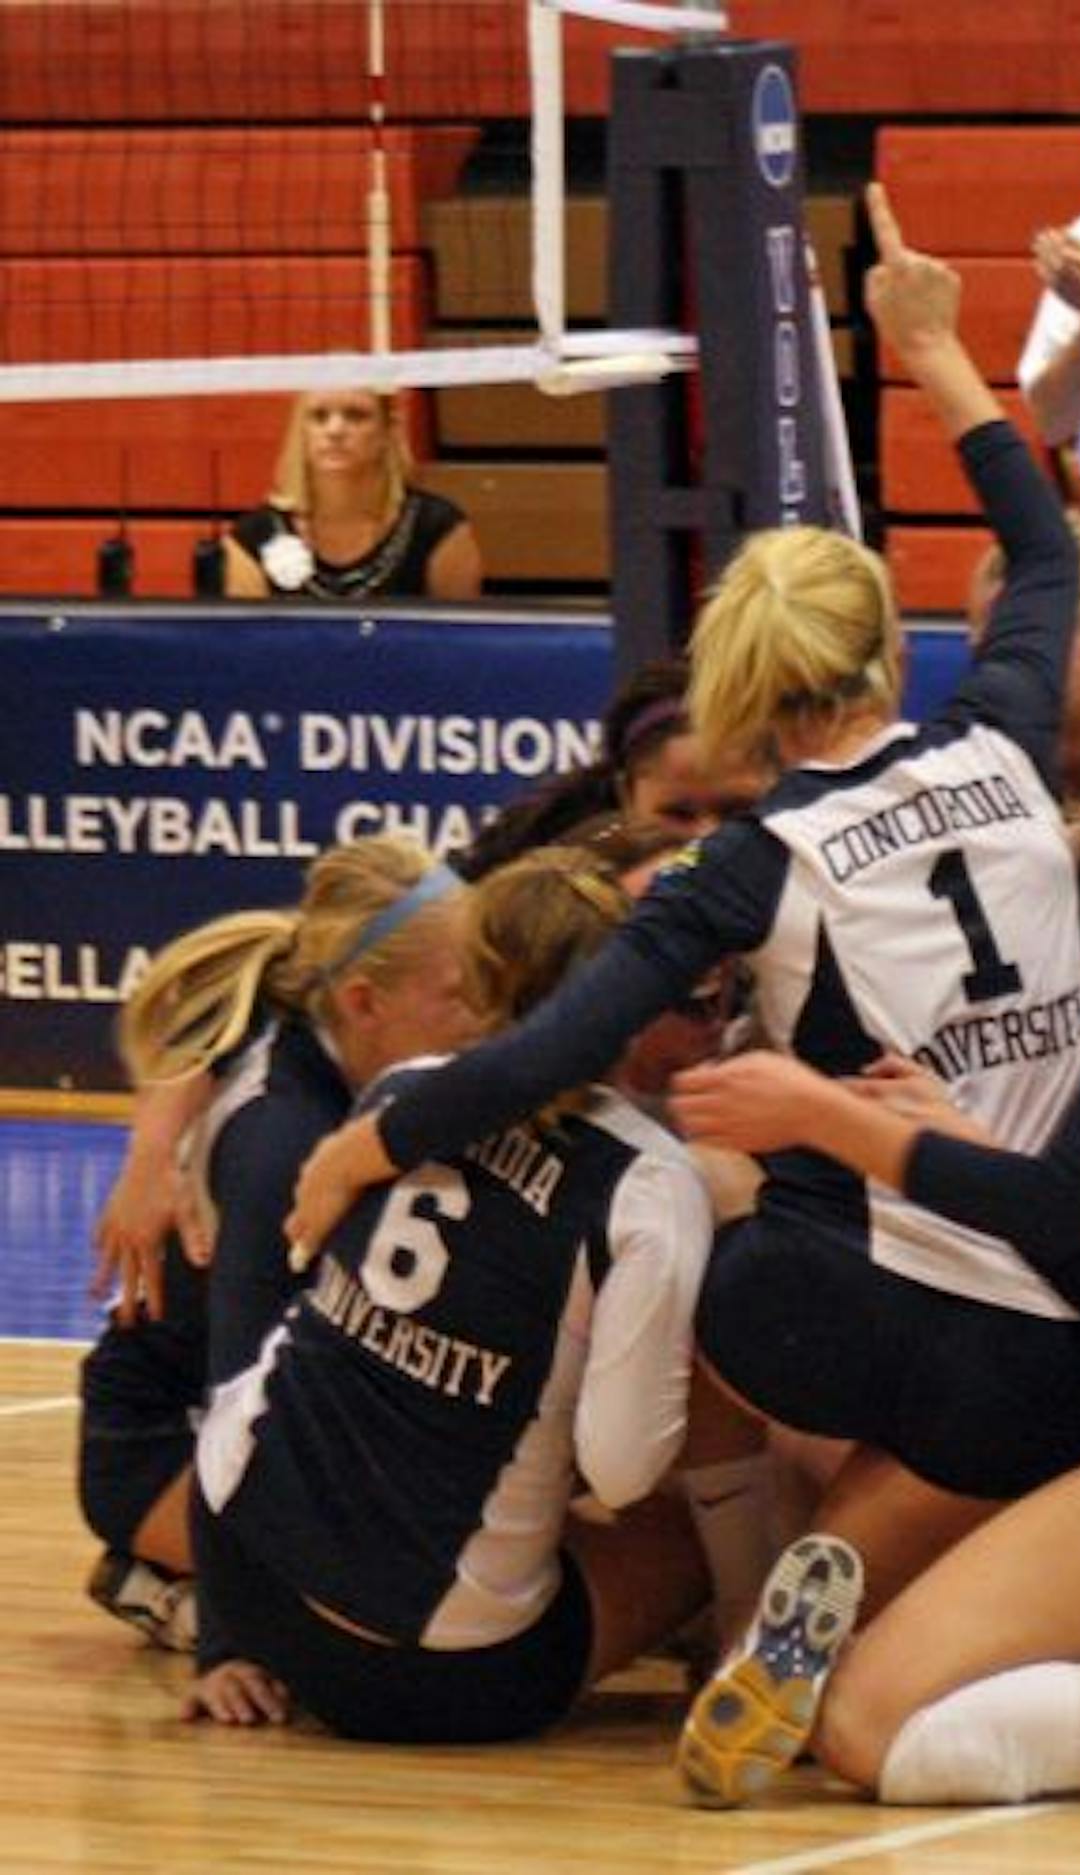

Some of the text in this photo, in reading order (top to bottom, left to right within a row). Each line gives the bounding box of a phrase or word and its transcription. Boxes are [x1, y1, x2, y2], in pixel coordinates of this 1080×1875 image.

[75, 710, 602, 775] NCAA DIVISION
[336, 800, 500, 859] CHA
[927, 847, 1024, 1004] 1
[0, 940, 153, 1001] ELLA
[360, 1161, 472, 1314] 6
